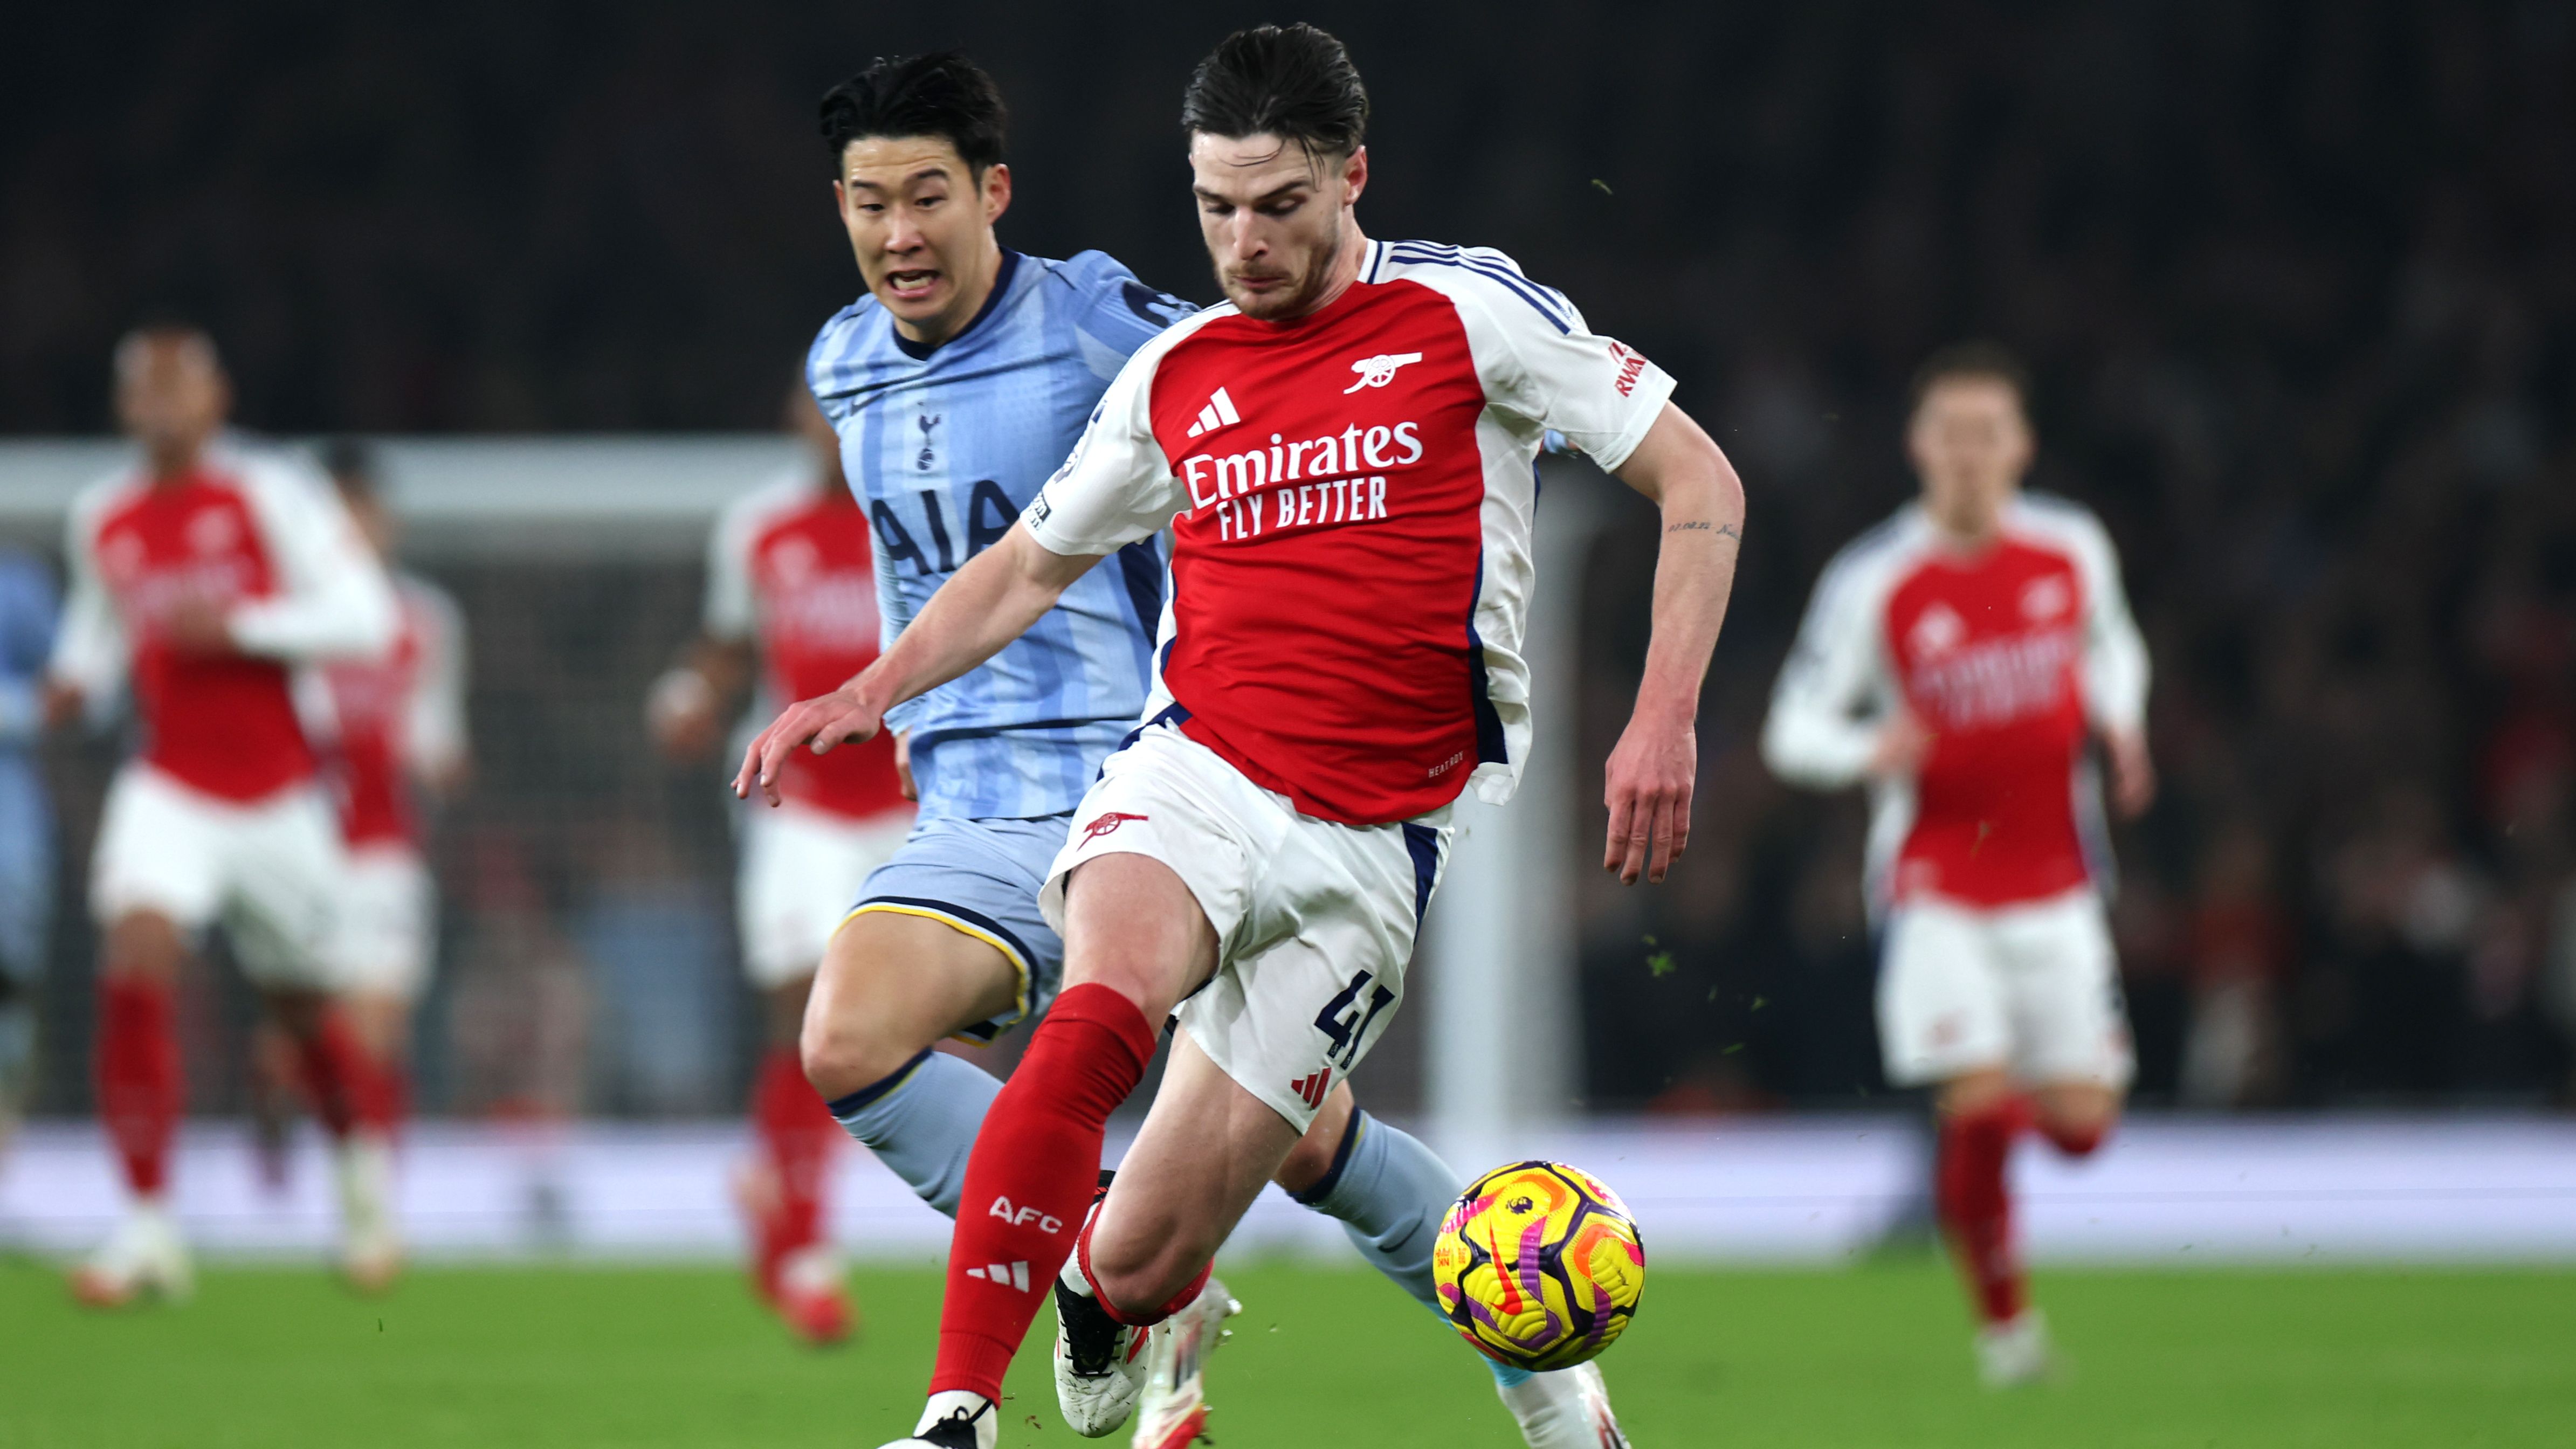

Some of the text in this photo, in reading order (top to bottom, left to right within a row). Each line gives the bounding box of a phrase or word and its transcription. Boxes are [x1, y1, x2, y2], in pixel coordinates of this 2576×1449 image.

[1183, 422, 1423, 509] Emirates
[1216, 476, 1387, 541] FLY BETTER
[871, 479, 1021, 575] AIA
[1313, 969, 1396, 1071] 41
[989, 1195, 1063, 1234] AFC
